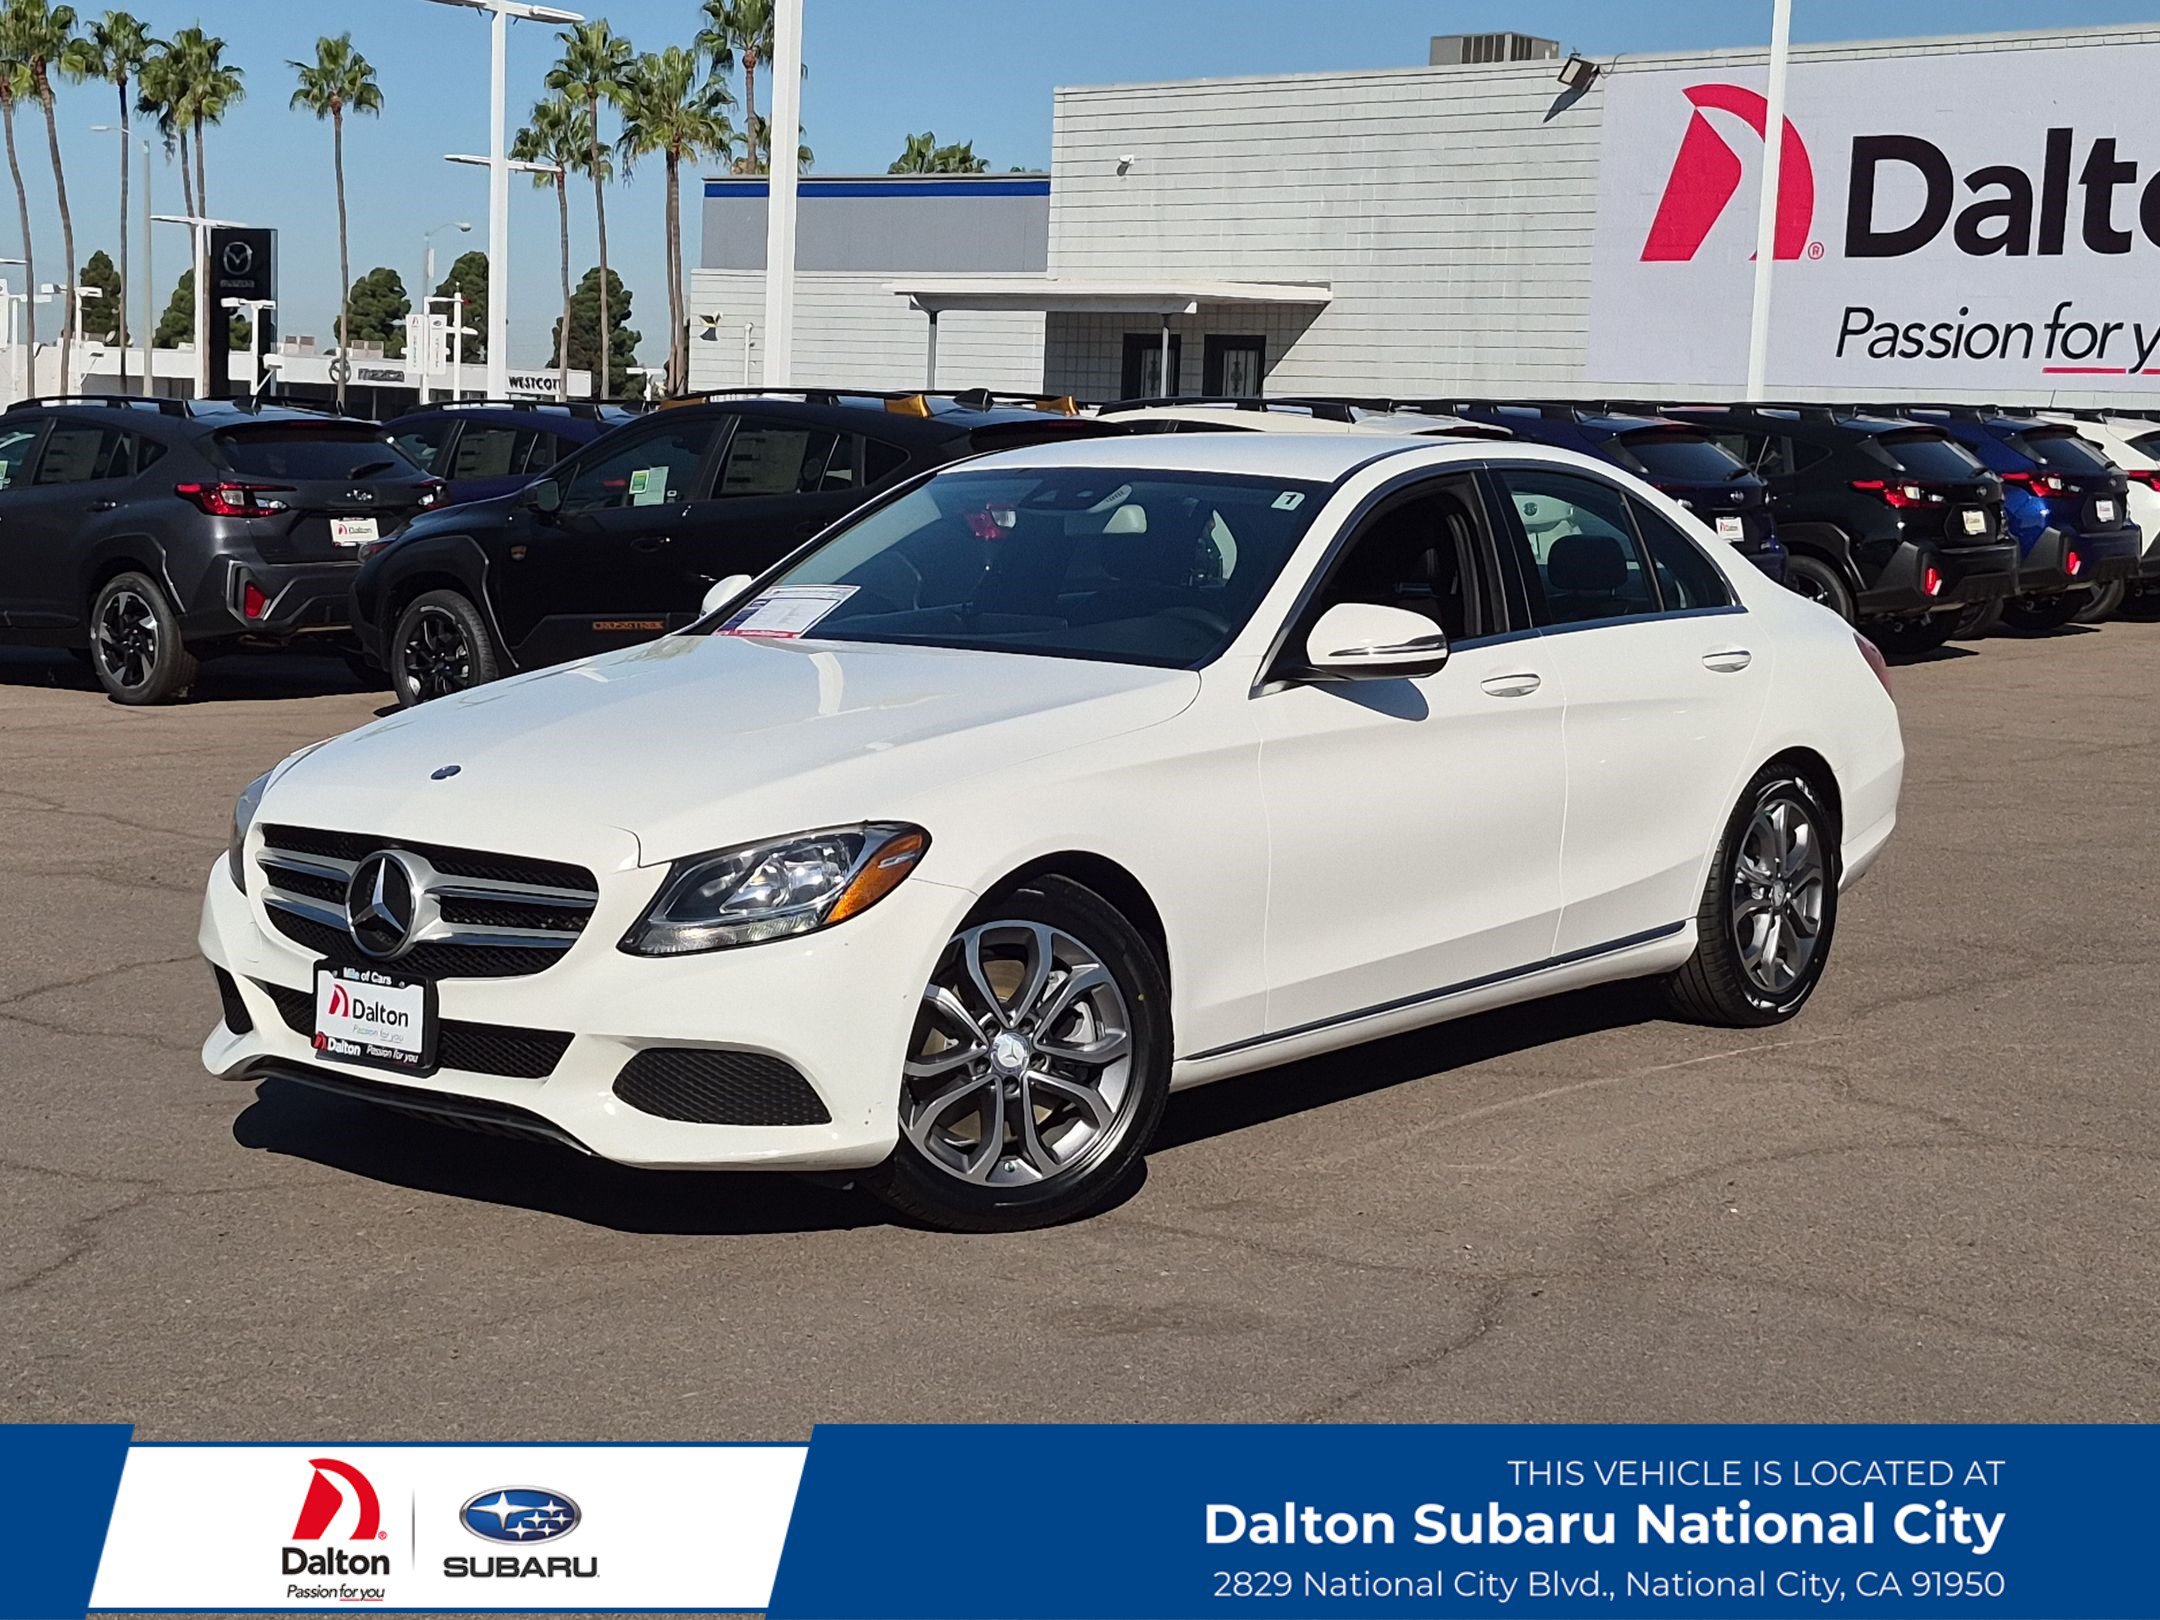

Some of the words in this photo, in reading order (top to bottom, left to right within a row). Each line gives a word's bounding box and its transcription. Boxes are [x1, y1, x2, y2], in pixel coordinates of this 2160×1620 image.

[1844, 127, 2160, 258] Dalt
[1835, 305, 2034, 360] Passion
[2043, 301, 2125, 360] for
[360, 971, 371, 982] of
[371, 972, 392, 985] Cars
[352, 998, 409, 1028] Dalton
[327, 1036, 361, 1057] Dalton
[366, 1044, 393, 1059] Passion
[393, 1050, 404, 1061] for
[403, 1053, 419, 1064] you
